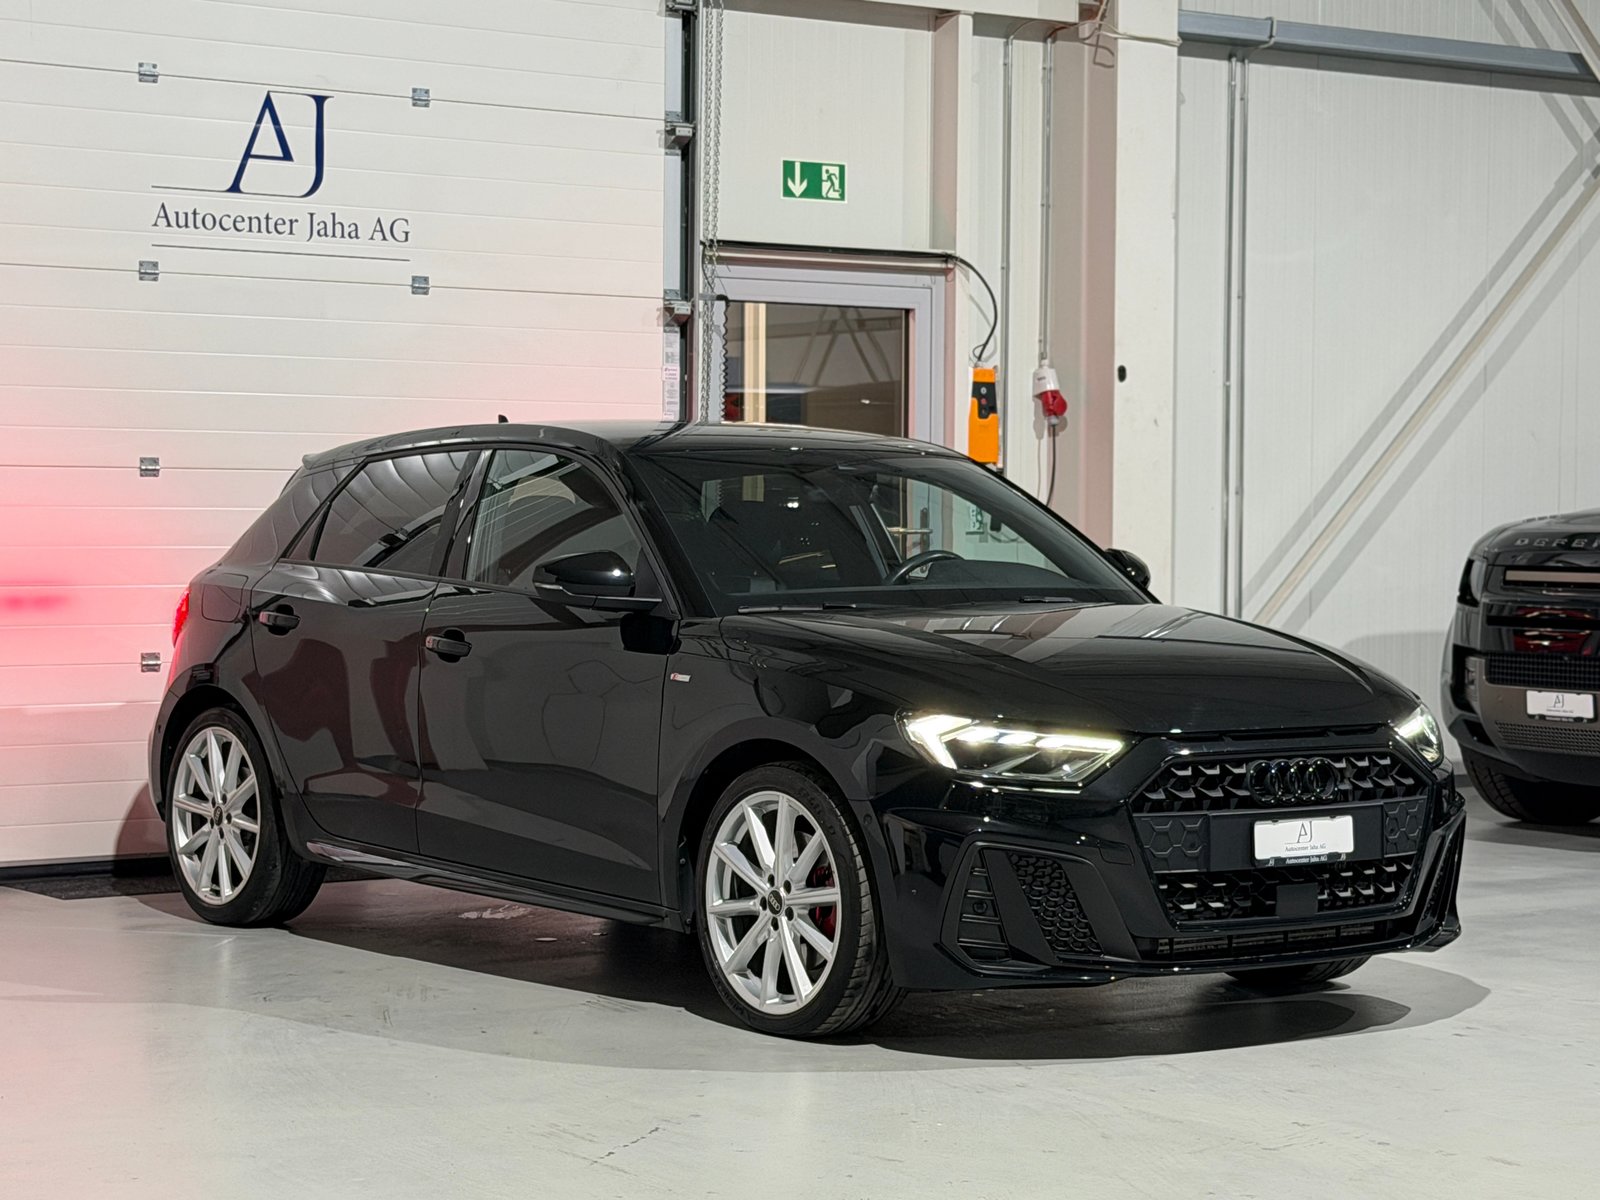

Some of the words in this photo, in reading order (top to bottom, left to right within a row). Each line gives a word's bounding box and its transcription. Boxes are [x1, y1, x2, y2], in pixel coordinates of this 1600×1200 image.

[224, 90, 335, 198] AJ
[151, 201, 299, 236] Autocenter
[306, 211, 361, 242] Jaha
[368, 216, 411, 243] AG
